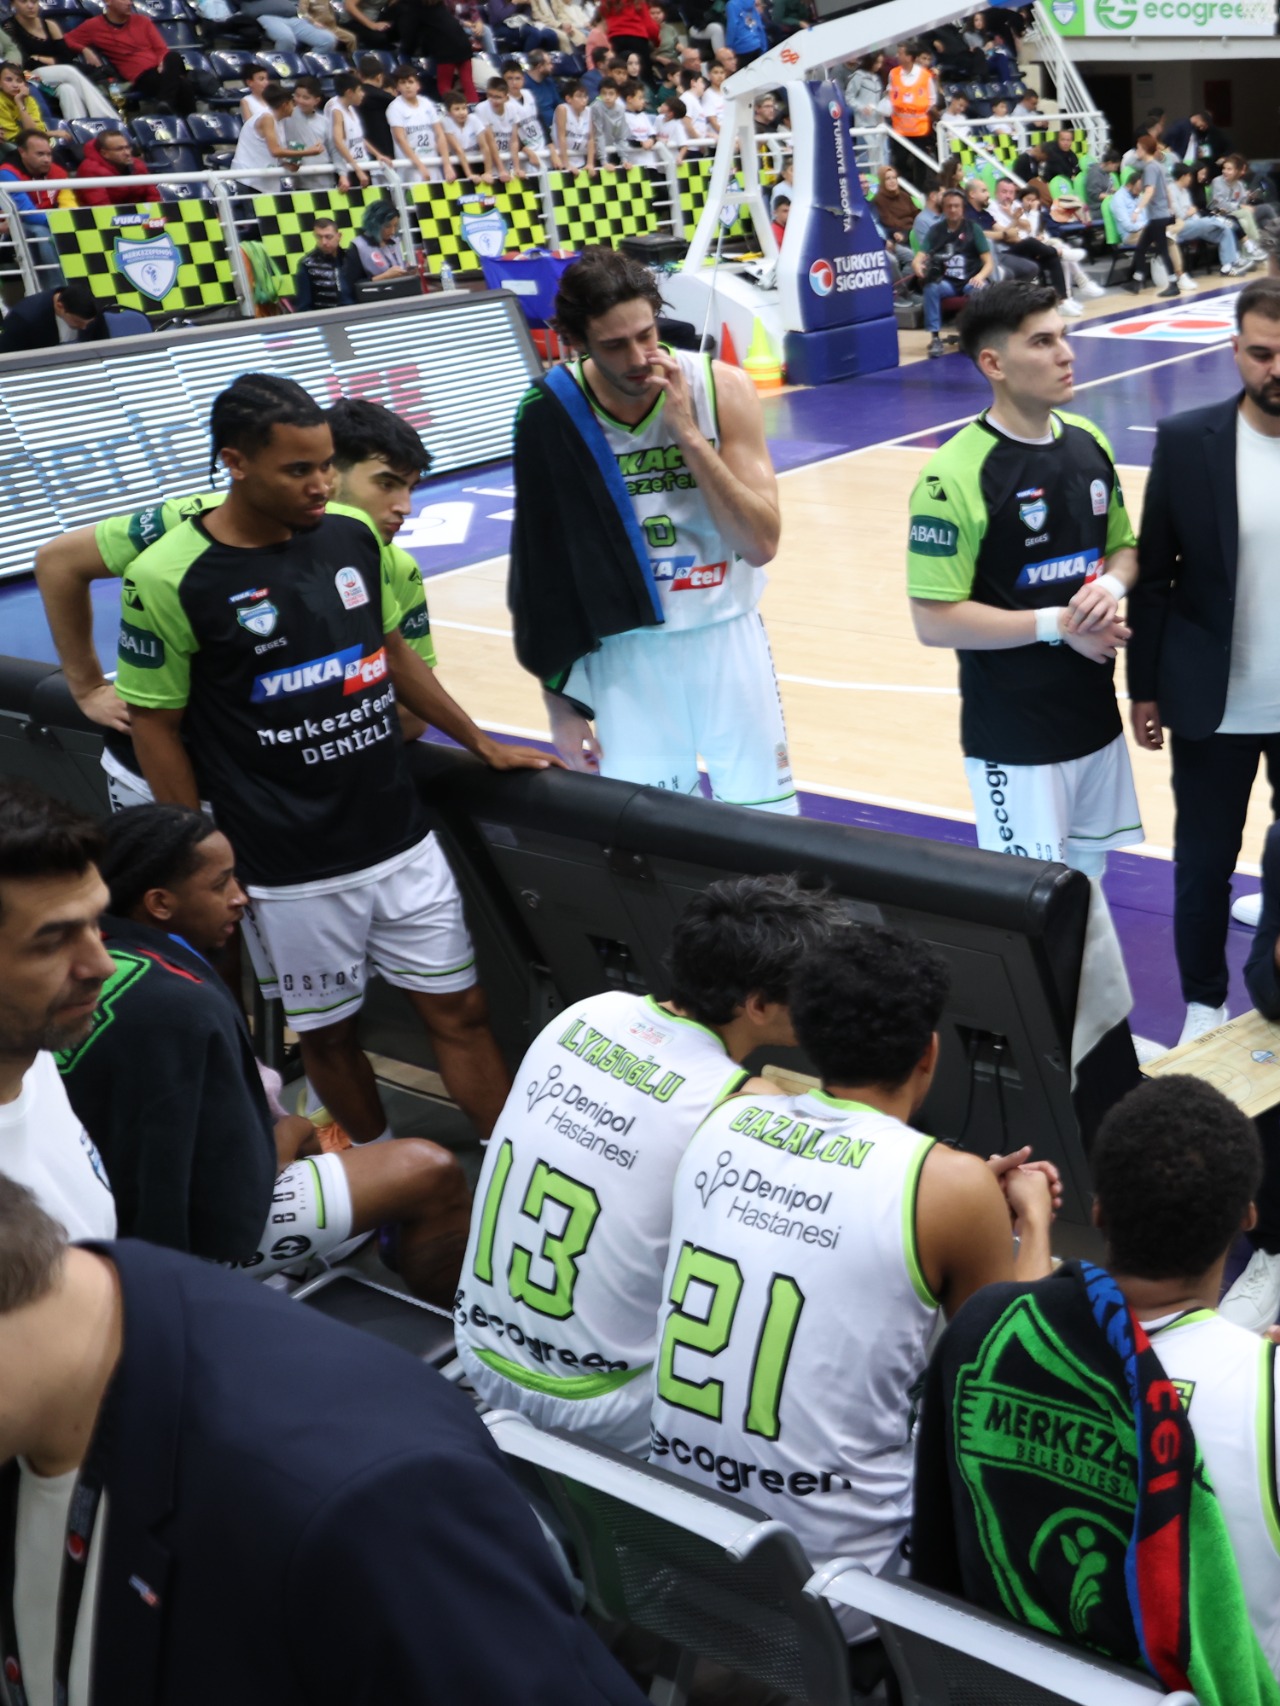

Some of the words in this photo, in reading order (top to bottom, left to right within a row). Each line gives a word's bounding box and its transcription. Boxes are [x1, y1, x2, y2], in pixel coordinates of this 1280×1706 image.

[1143, 1, 1264, 27] ecogree
[1027, 556, 1087, 585] YUKA
[119, 630, 156, 658] BALI
[260, 658, 344, 697] YUKA
[361, 653, 387, 684] tel
[562, 1084, 637, 1137] Denipol
[545, 1106, 639, 1171] Hastanesi
[741, 1168, 834, 1215] Denipol
[473, 1137, 602, 1321] 13
[726, 1195, 842, 1250] Hastanesi
[657, 1239, 806, 1443] 21
[651, 1426, 853, 1497] ecogreen
